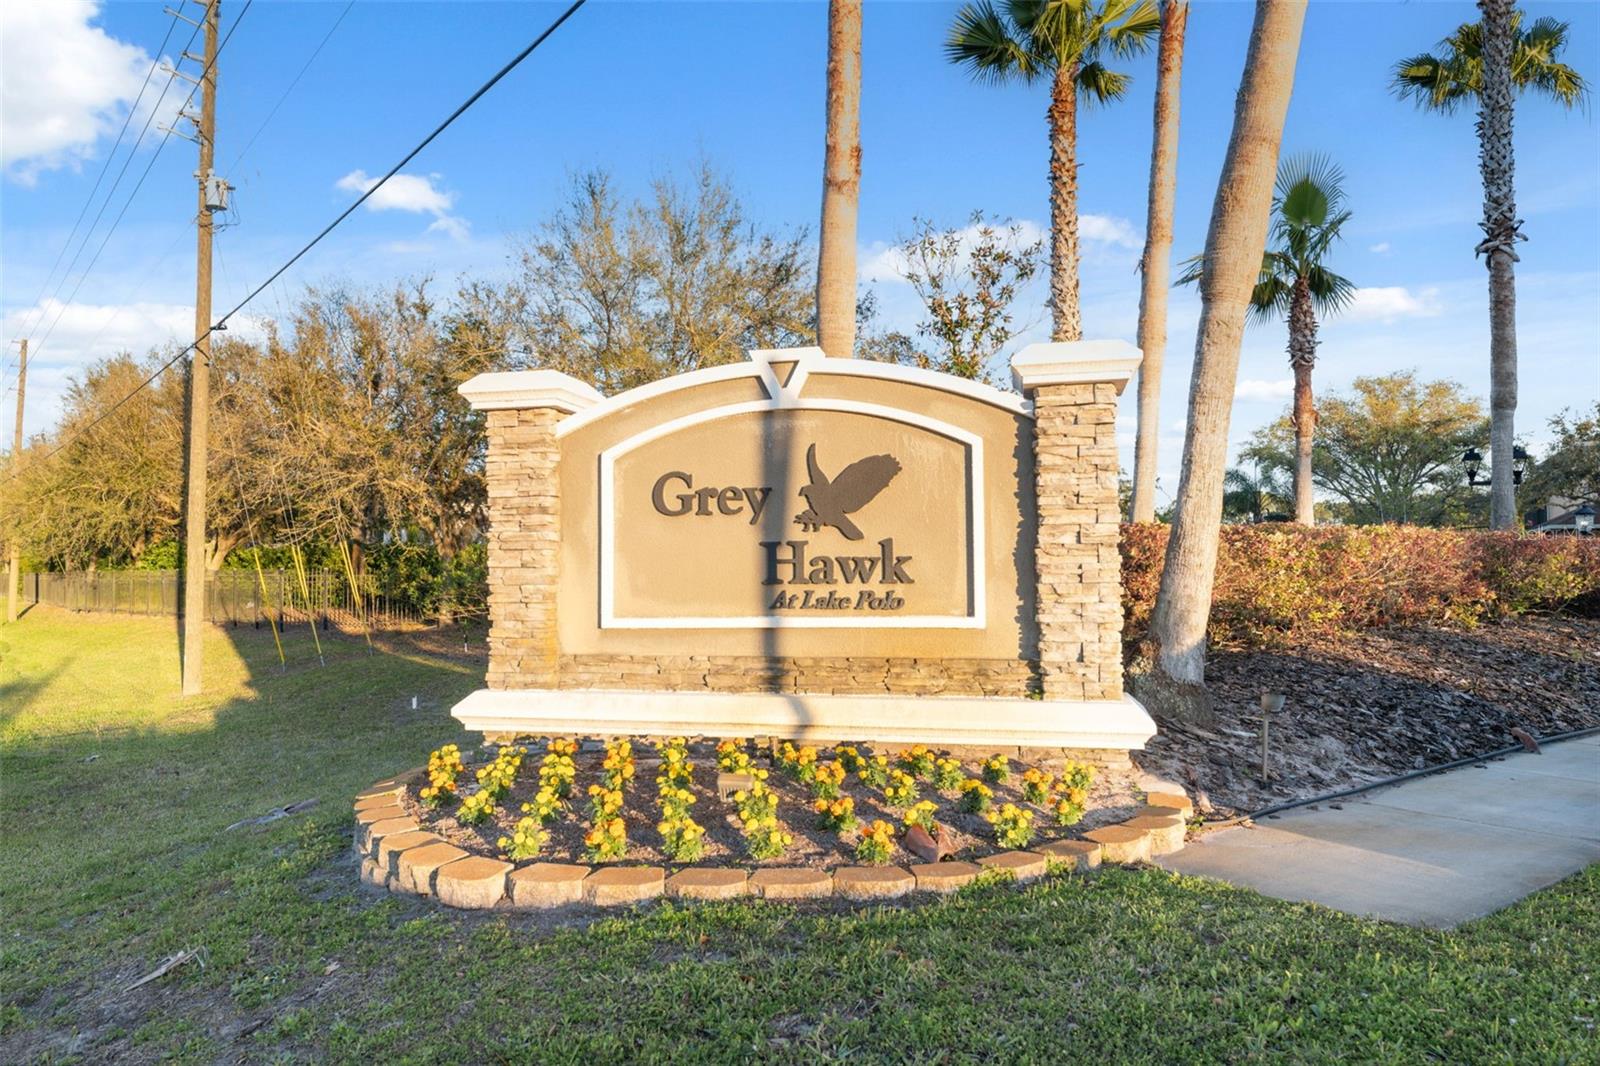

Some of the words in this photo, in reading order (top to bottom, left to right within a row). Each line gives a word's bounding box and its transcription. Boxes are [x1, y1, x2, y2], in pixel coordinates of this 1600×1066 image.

[652, 471, 772, 525] Grey
[759, 538, 915, 584] Hawk
[769, 591, 799, 609] At
[800, 590, 851, 609] Lake
[854, 590, 905, 610] Polo
